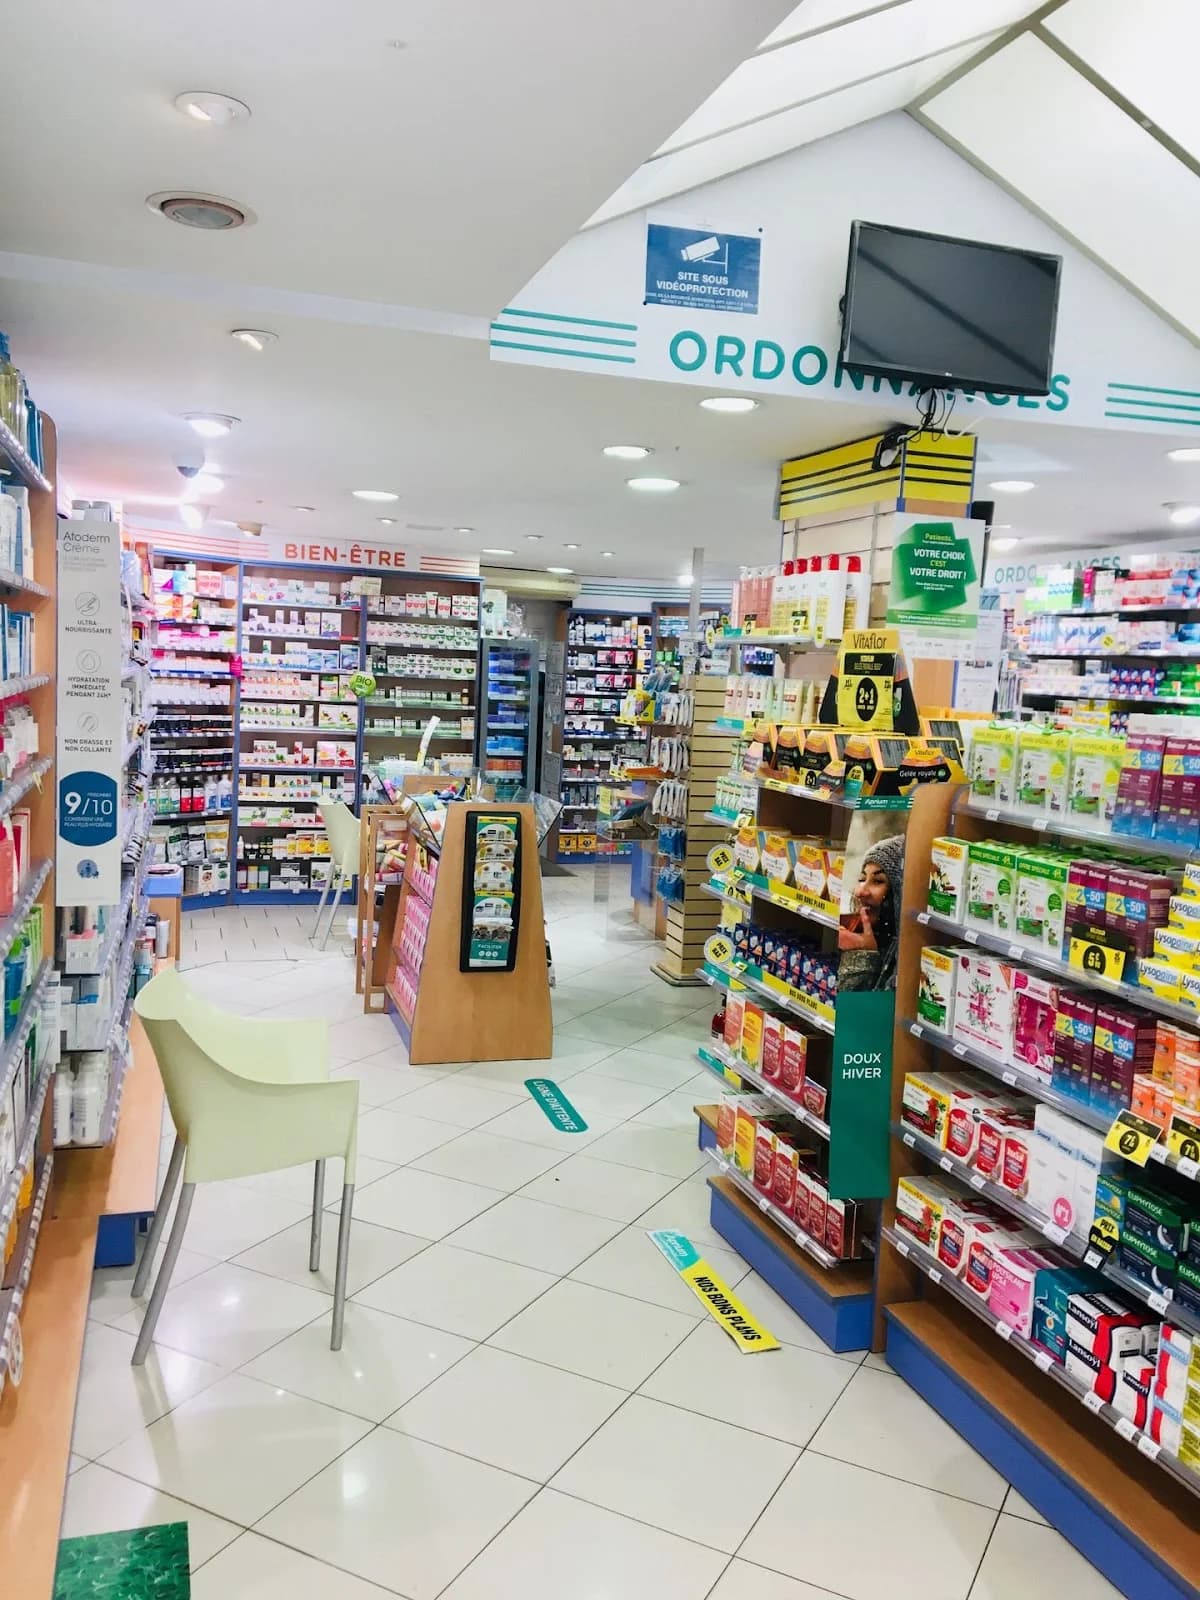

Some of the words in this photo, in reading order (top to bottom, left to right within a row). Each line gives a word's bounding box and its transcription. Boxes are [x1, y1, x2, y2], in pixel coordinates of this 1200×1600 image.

[678, 271, 699, 282] SITE
[702, 274, 729, 286] SOUS
[656, 280, 749, 298] VIDÉOPROTECTION
[63, 531, 111, 543] Atoderm
[63, 542, 100, 554] Crème
[913, 548, 941, 559] VOTRE
[941, 550, 966, 561] CHOIX
[285, 543, 406, 568] BIEN-ÊTRE
[910, 567, 937, 577] VOTRE
[937, 569, 963, 579] DROIT
[65, 626, 112, 634] NOURRISSANTE
[68, 676, 110, 684] HYDRATATION
[355, 675, 372, 686] BIO
[899, 770, 916, 778] Gelée
[917, 771, 937, 780] royale
[65, 791, 113, 815] 9/10
[843, 1052, 882, 1065] DOUX
[842, 1067, 882, 1080] HIVER
[1127, 1190, 1163, 1217] EUPHYTOSE
[1122, 1231, 1158, 1258] EUPHYTOSE
[693, 1276, 719, 1292] NOS
[706, 1293, 738, 1315] BONS
[725, 1315, 762, 1340] PLANS
